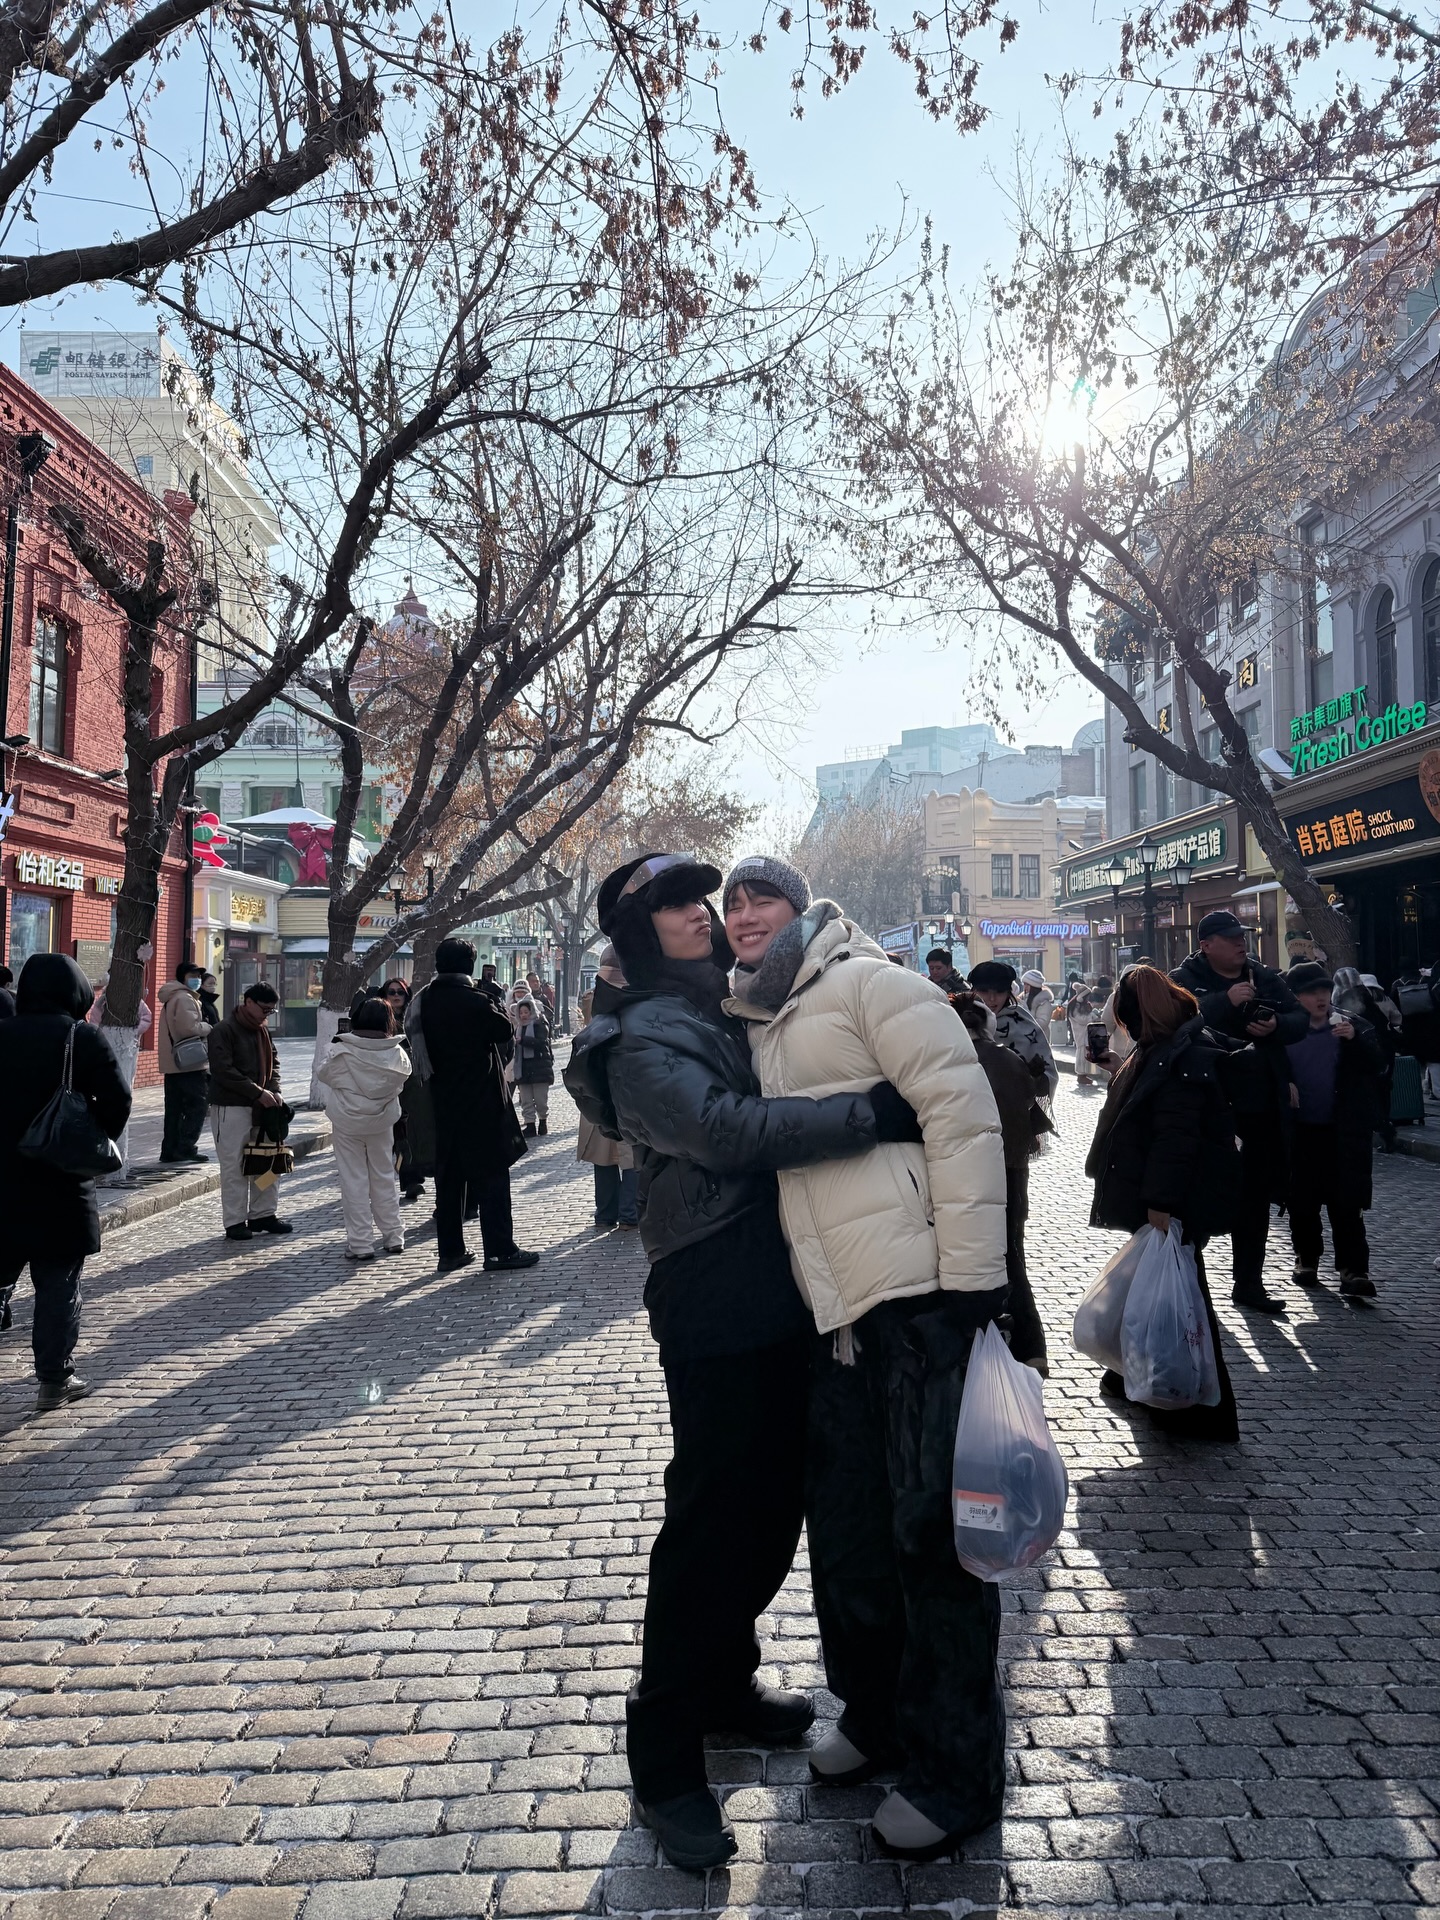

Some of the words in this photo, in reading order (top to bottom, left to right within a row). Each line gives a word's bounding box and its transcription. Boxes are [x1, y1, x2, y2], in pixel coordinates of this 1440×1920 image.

[65, 350, 150, 371] 邮储银行
[65, 371, 93, 379] POSTAL
[95, 371, 129, 379] SAVINGS
[130, 371, 152, 379] BANK
[1289, 685, 1368, 743] 京东集团旗下
[1289, 727, 1350, 778] 7Fresh
[1355, 700, 1427, 751] Coffee
[1295, 808, 1368, 857] 肖克庭院
[1367, 809, 1393, 827] SHOCK
[1370, 818, 1416, 839] COURTYARD
[1158, 827, 1221, 872] 俄罗斯产品馆
[17, 850, 84, 891] 怡和名品
[980, 920, 1032, 939] Торговый
[1034, 924, 1069, 939] центр
